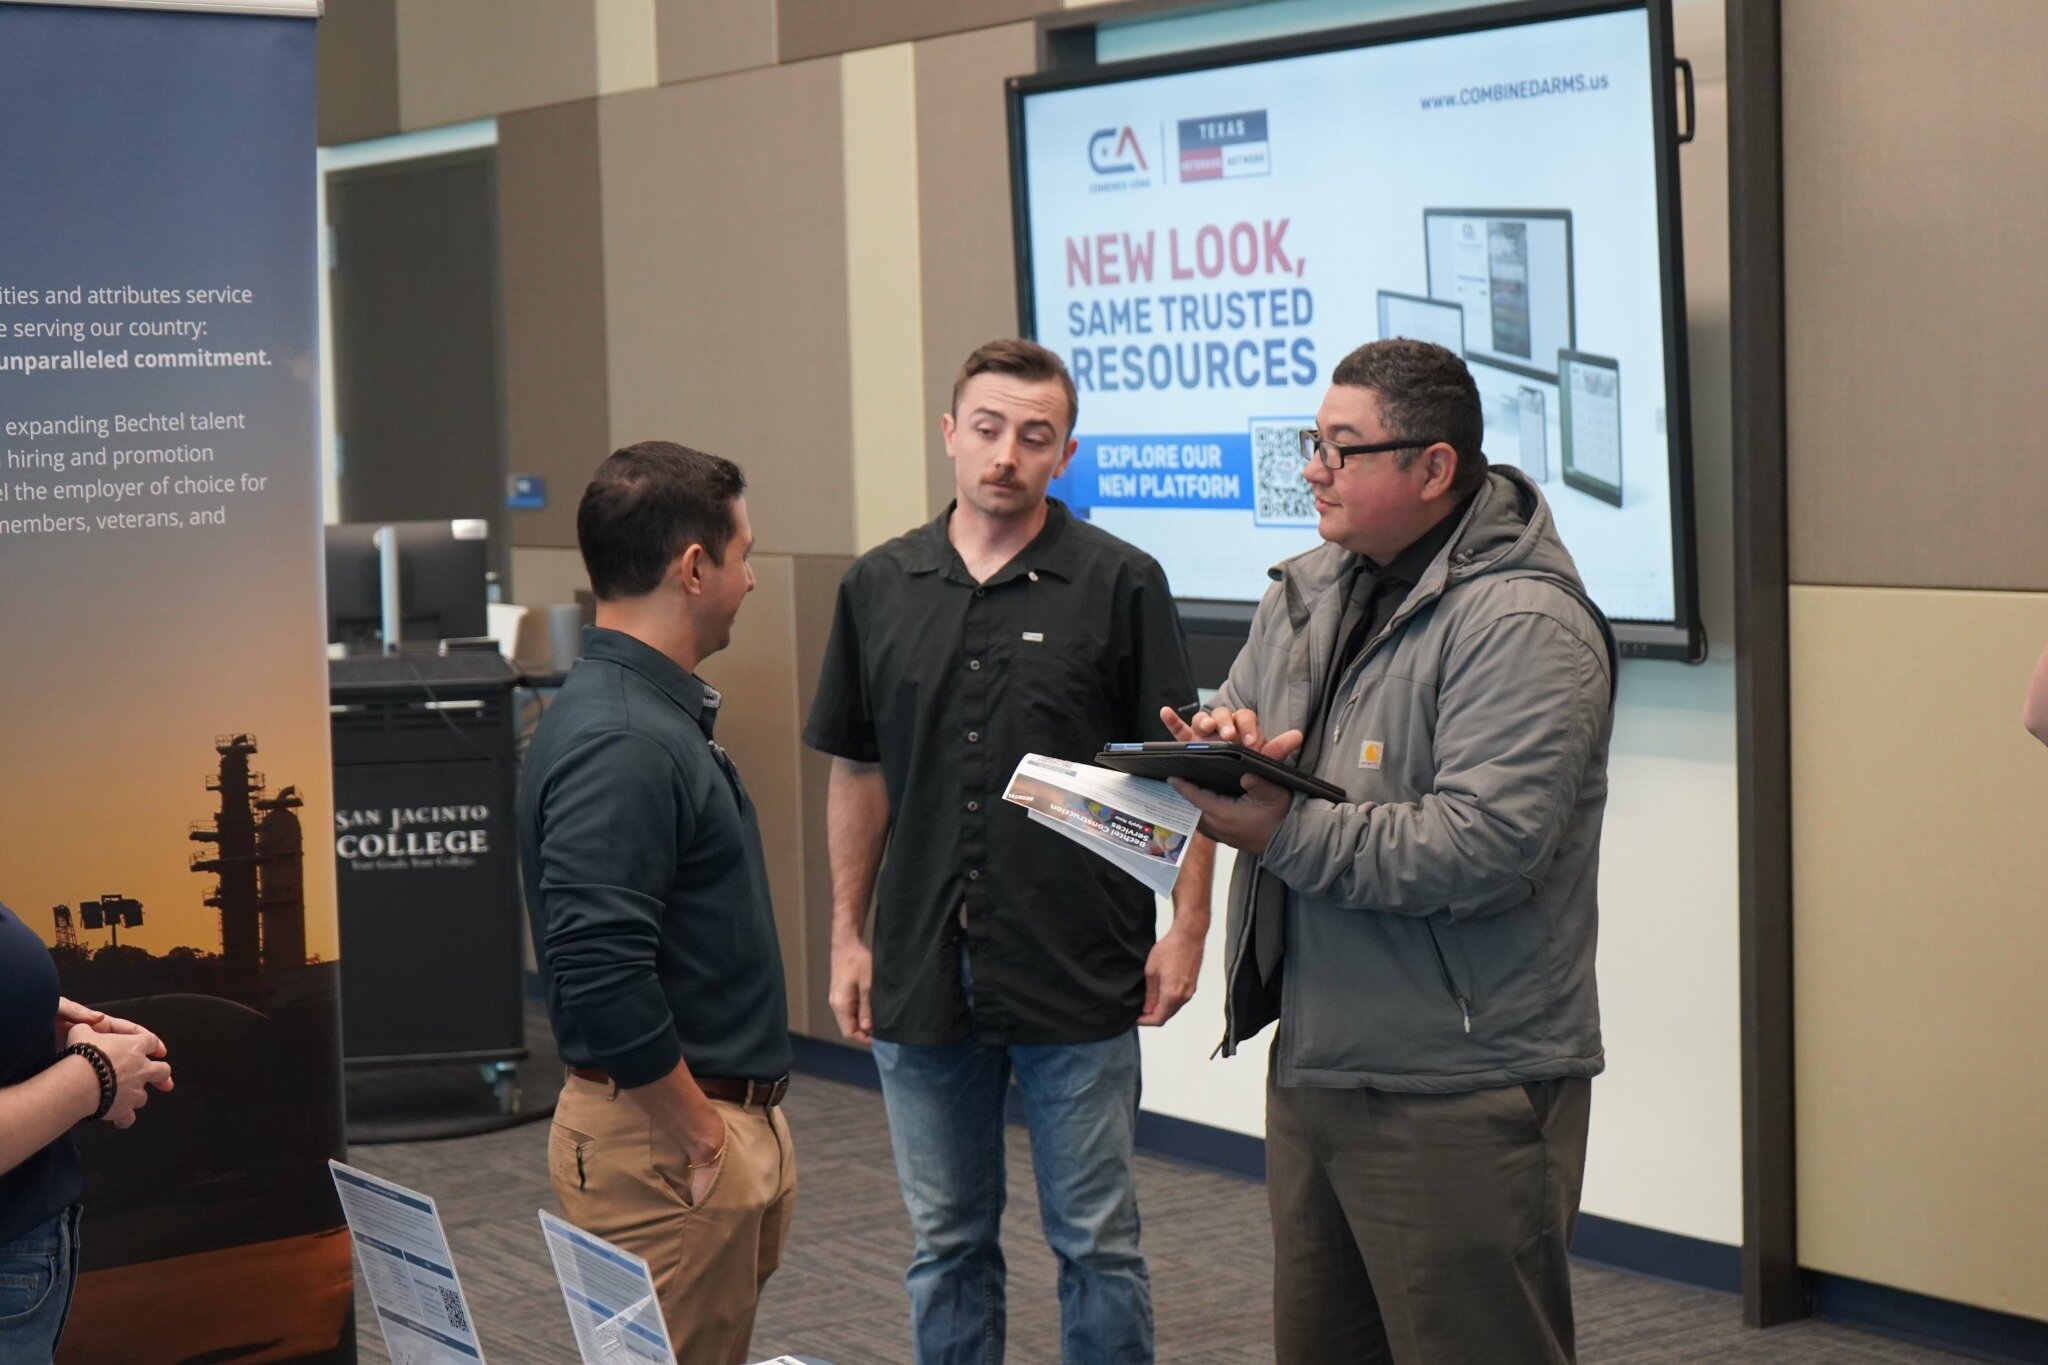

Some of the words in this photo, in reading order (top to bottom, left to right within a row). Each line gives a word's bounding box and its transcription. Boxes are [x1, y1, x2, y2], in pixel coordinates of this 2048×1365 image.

[1420, 73, 1609, 109] www.COMBINEDARMS.us
[1199, 119, 1245, 139] TEXAS
[1065, 230, 1155, 287] NEW
[1169, 218, 1306, 280] LOOK,
[46, 285, 82, 304] and
[88, 285, 181, 304] attributes
[186, 285, 253, 303] service
[1068, 297, 1152, 337] SAME
[1159, 286, 1314, 333] TRUSTED
[13, 319, 85, 341] serving
[90, 320, 123, 337] our
[129, 318, 208, 340] country:
[0, 349, 129, 375] unparalleled
[134, 348, 272, 369] commitment.
[1072, 337, 1318, 392] RESOURCES
[5, 415, 109, 440] expanding
[115, 412, 185, 432] Bechtel
[190, 411, 246, 431] talent
[7, 449, 65, 472] hiring
[70, 447, 107, 467] and
[113, 444, 214, 469] promotion
[1097, 445, 1180, 469] EXPLORE
[1182, 444, 1222, 469] OUR
[0, 482, 8, 500] l
[15, 481, 47, 500] the
[53, 478, 144, 503] employer
[150, 476, 170, 496] of
[174, 475, 235, 495] choice
[240, 473, 268, 491] for
[1098, 474, 1137, 498] NEW
[1140, 474, 1240, 498] PLATFORM
[96, 510, 184, 531] veterans,
[189, 506, 226, 525] and
[335, 808, 382, 831] SAN
[388, 804, 489, 832] JACINTO
[1050, 803, 1110, 832] Construction
[336, 829, 489, 859] COLLEGE
[1110, 829, 1147, 848] Bechtel
[1111, 822, 1150, 842] Services
